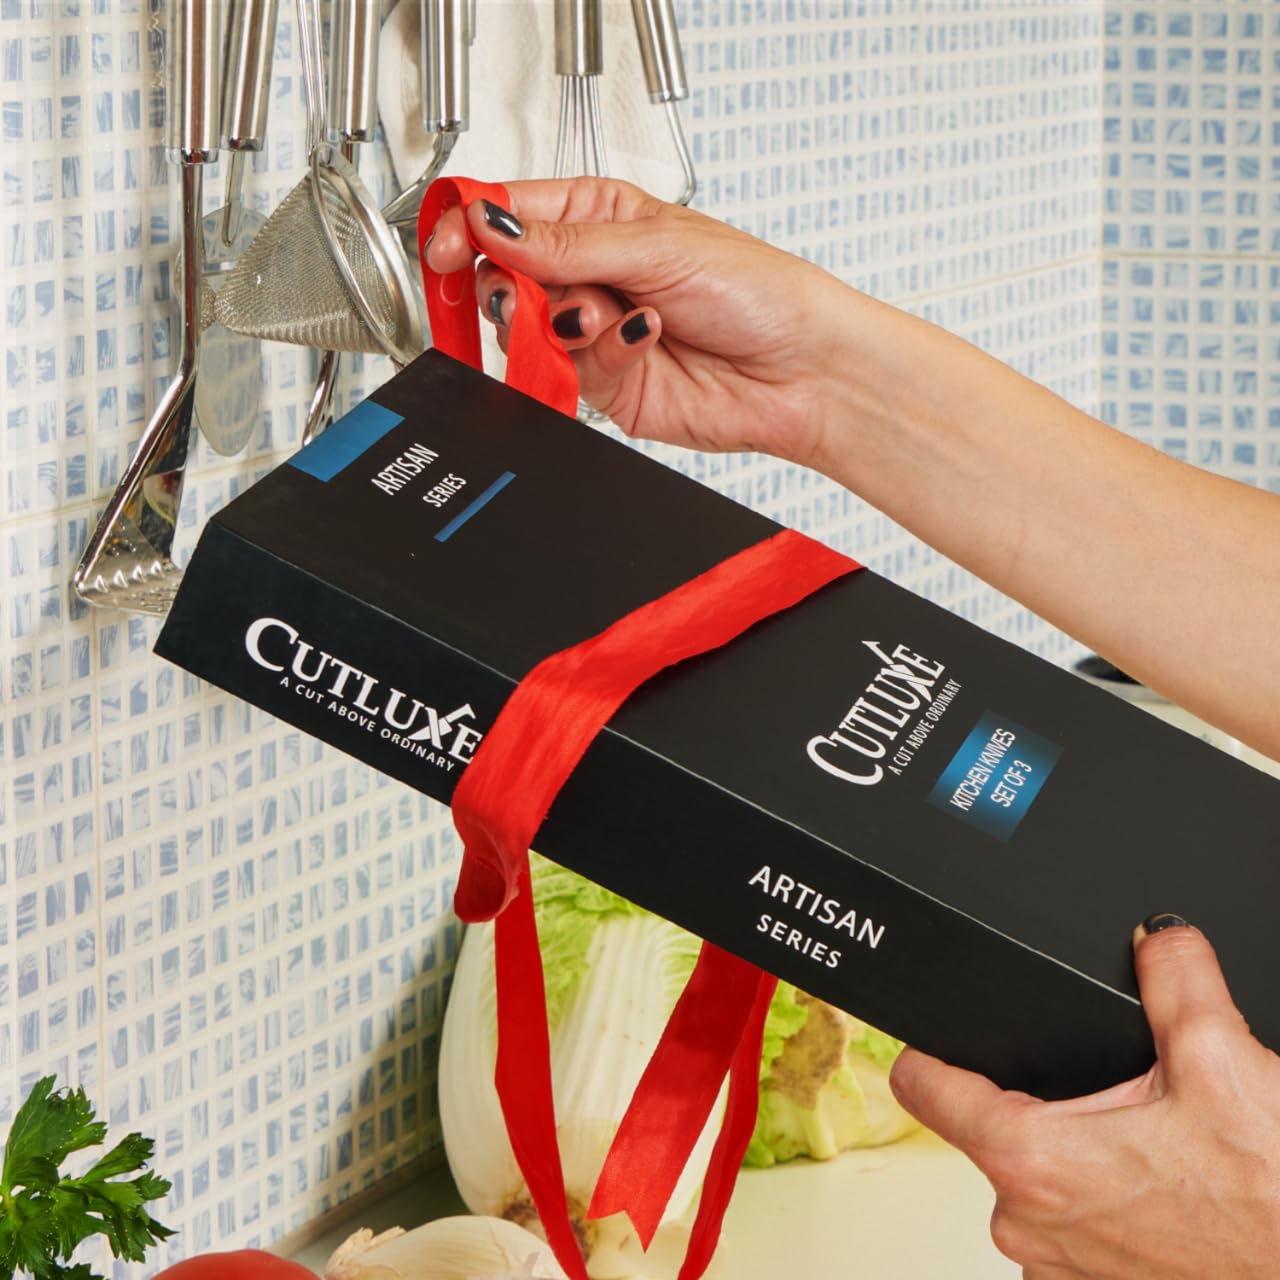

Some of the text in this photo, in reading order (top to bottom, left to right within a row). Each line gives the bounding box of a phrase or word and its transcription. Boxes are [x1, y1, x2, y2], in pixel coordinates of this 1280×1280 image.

[371, 443, 439, 496] ARTISAN
[422, 473, 467, 508] SERIES
[245, 617, 483, 764] CUTLUXE
[280, 676, 455, 772] A CUT ABOVE ORDINARY
[806, 640, 946, 786] CUTLUXE
[888, 678, 962, 776] A CUT ABOVE ORDINARY
[950, 728, 1016, 811] KITCHEN KNIVES
[990, 760, 1032, 807] SET OF 3
[748, 865, 886, 949] ARTISAN
[756, 914, 842, 968] SERIES
